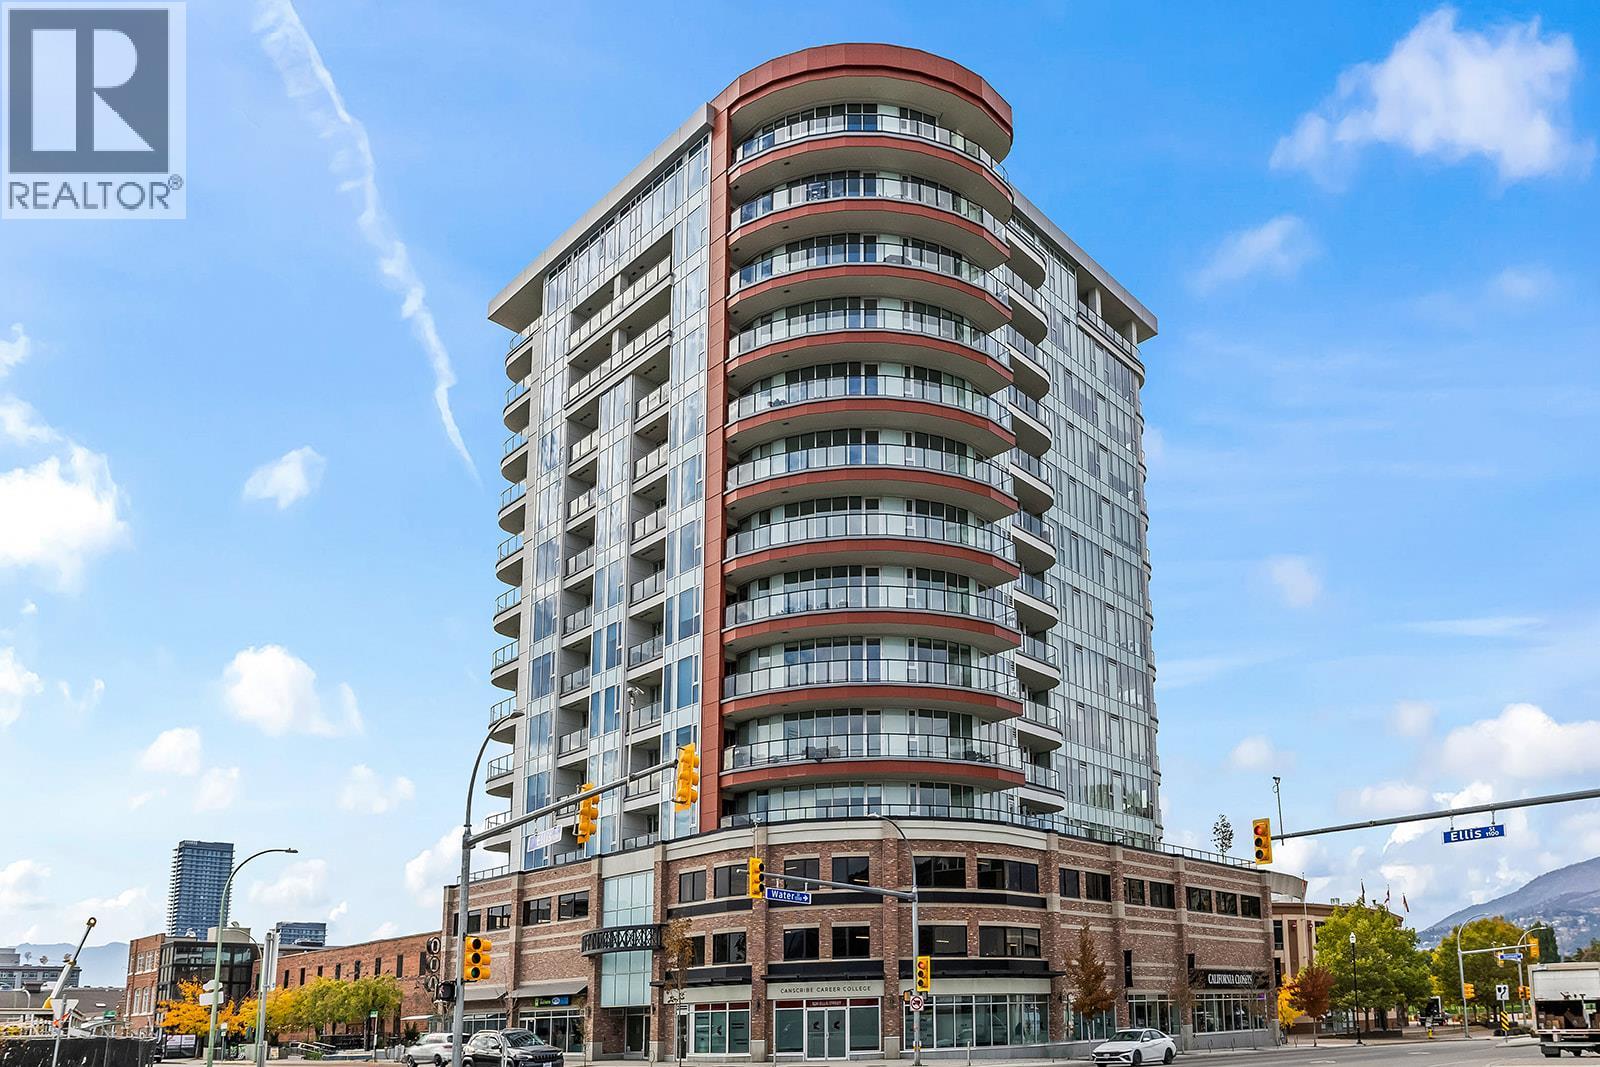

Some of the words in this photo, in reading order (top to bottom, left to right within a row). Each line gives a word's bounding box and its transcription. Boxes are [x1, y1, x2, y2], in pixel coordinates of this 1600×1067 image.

[1450, 829, 1482, 841] Ellis
[771, 889, 795, 900] Water
[1207, 973, 1235, 985] CALIFORNIA
